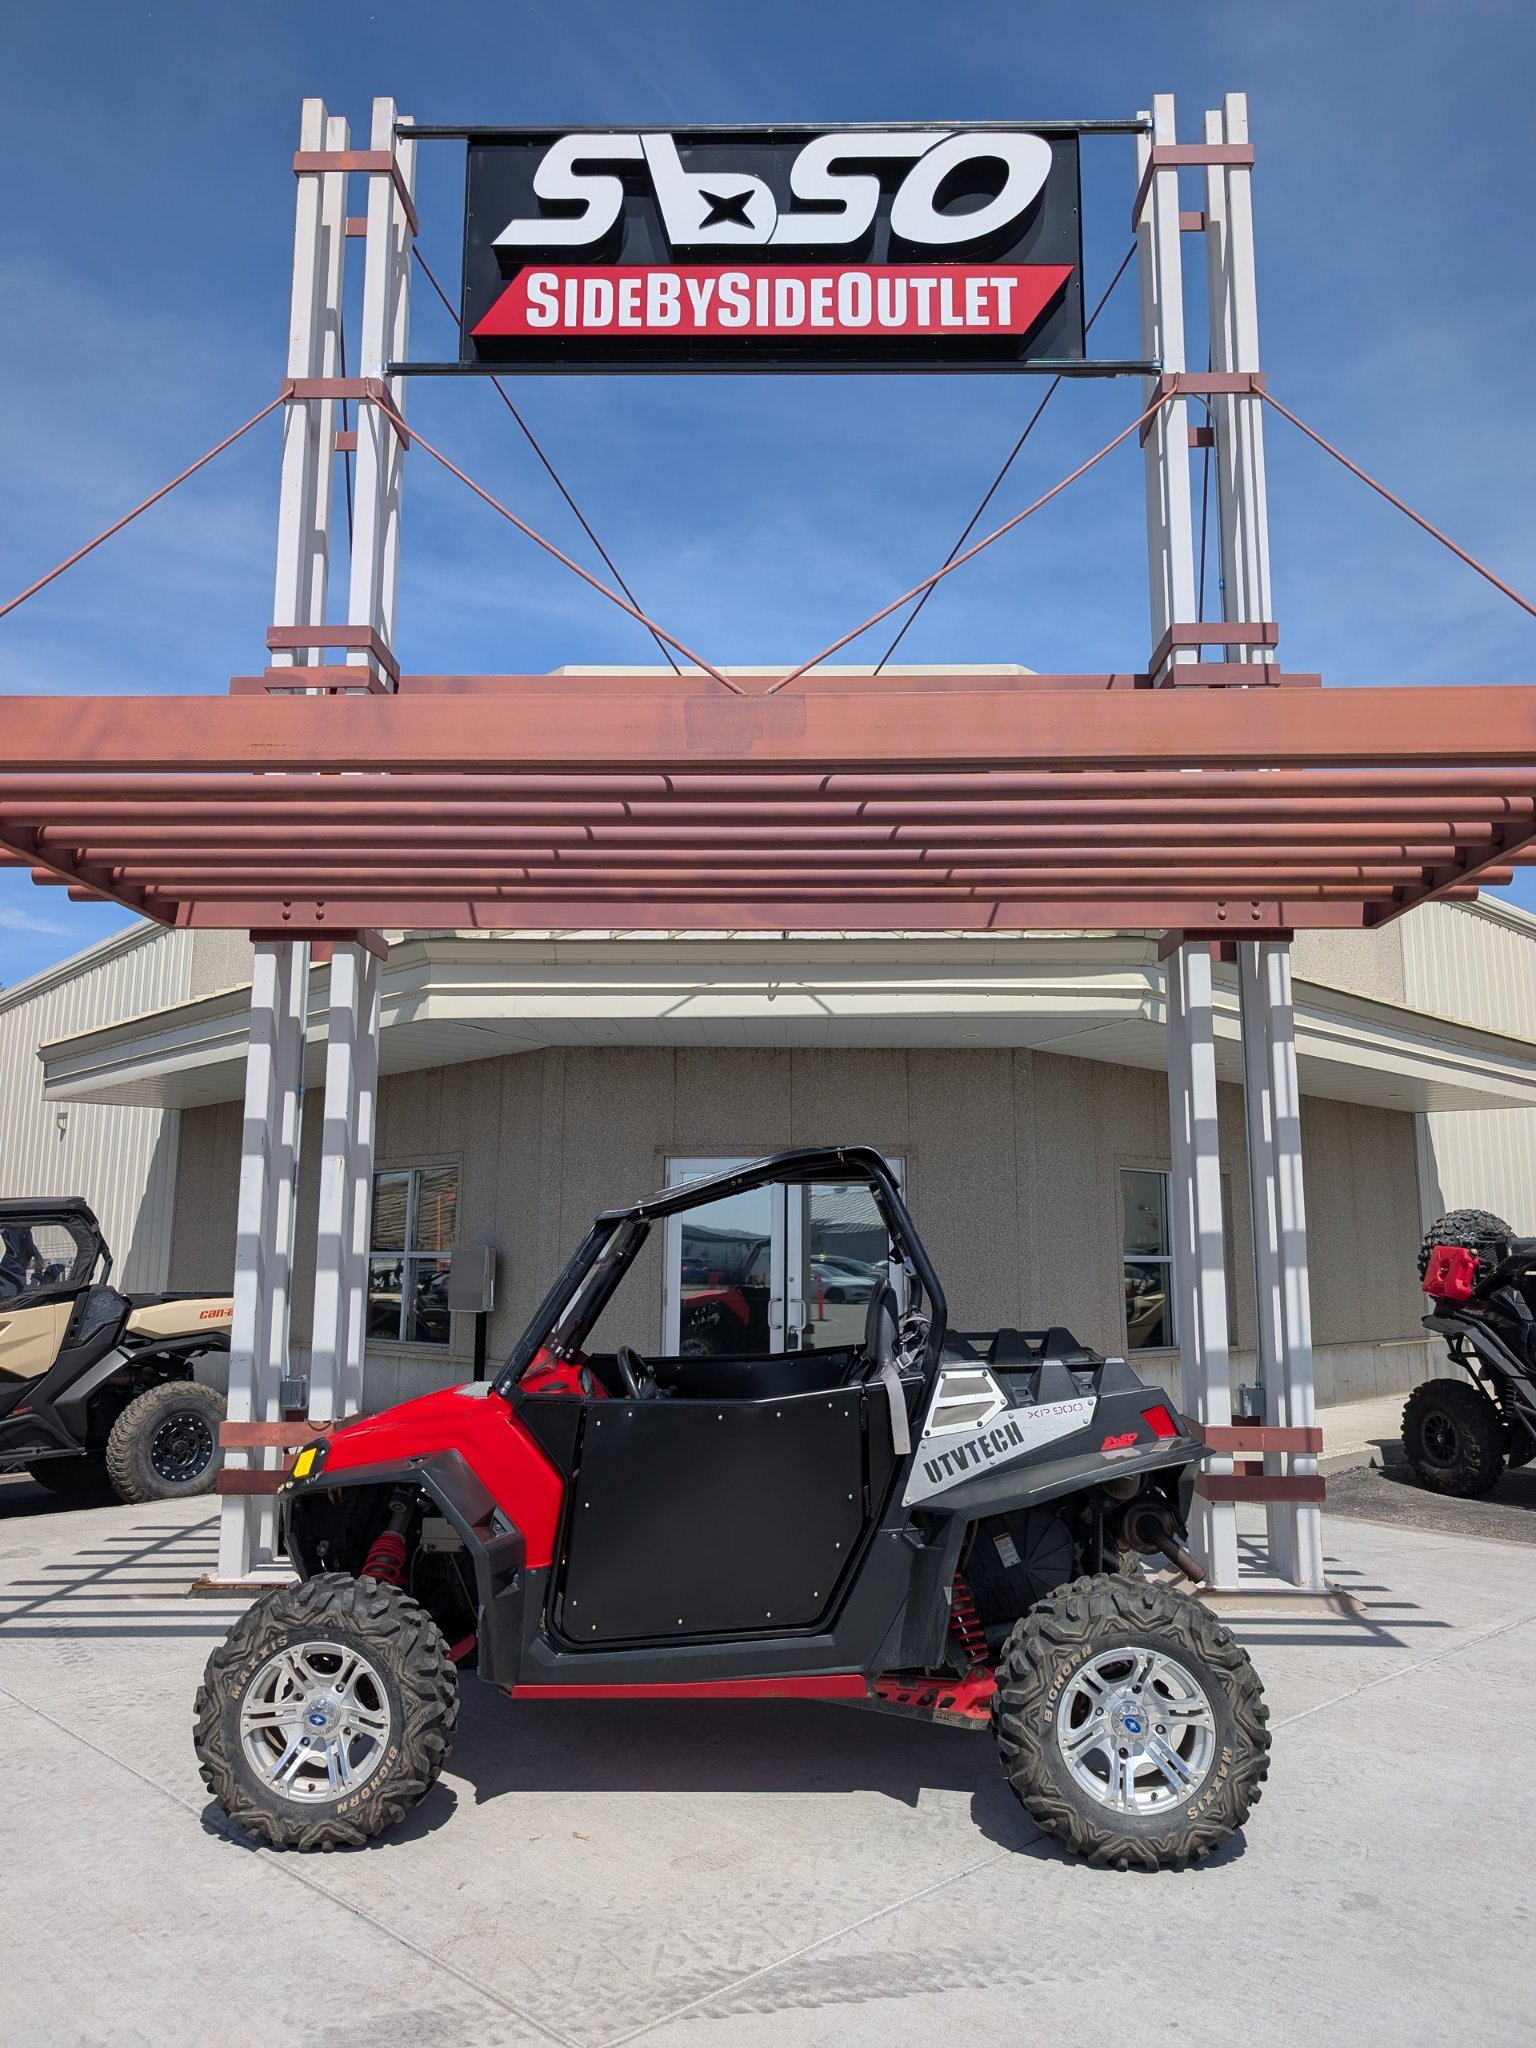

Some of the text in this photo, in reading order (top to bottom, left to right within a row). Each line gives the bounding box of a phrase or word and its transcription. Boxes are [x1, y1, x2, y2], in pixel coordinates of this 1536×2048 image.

[199, 1307, 234, 1320] can-a
[1052, 1402, 1083, 1415] 900
[923, 1420, 1025, 1484] UTVTECH
[230, 1634, 289, 1701] MAXXIS
[1043, 1644, 1093, 1723] BIGHORN
[336, 1745, 399, 1815] BIGHORN
[1187, 1745, 1233, 1820] MAXXIS
